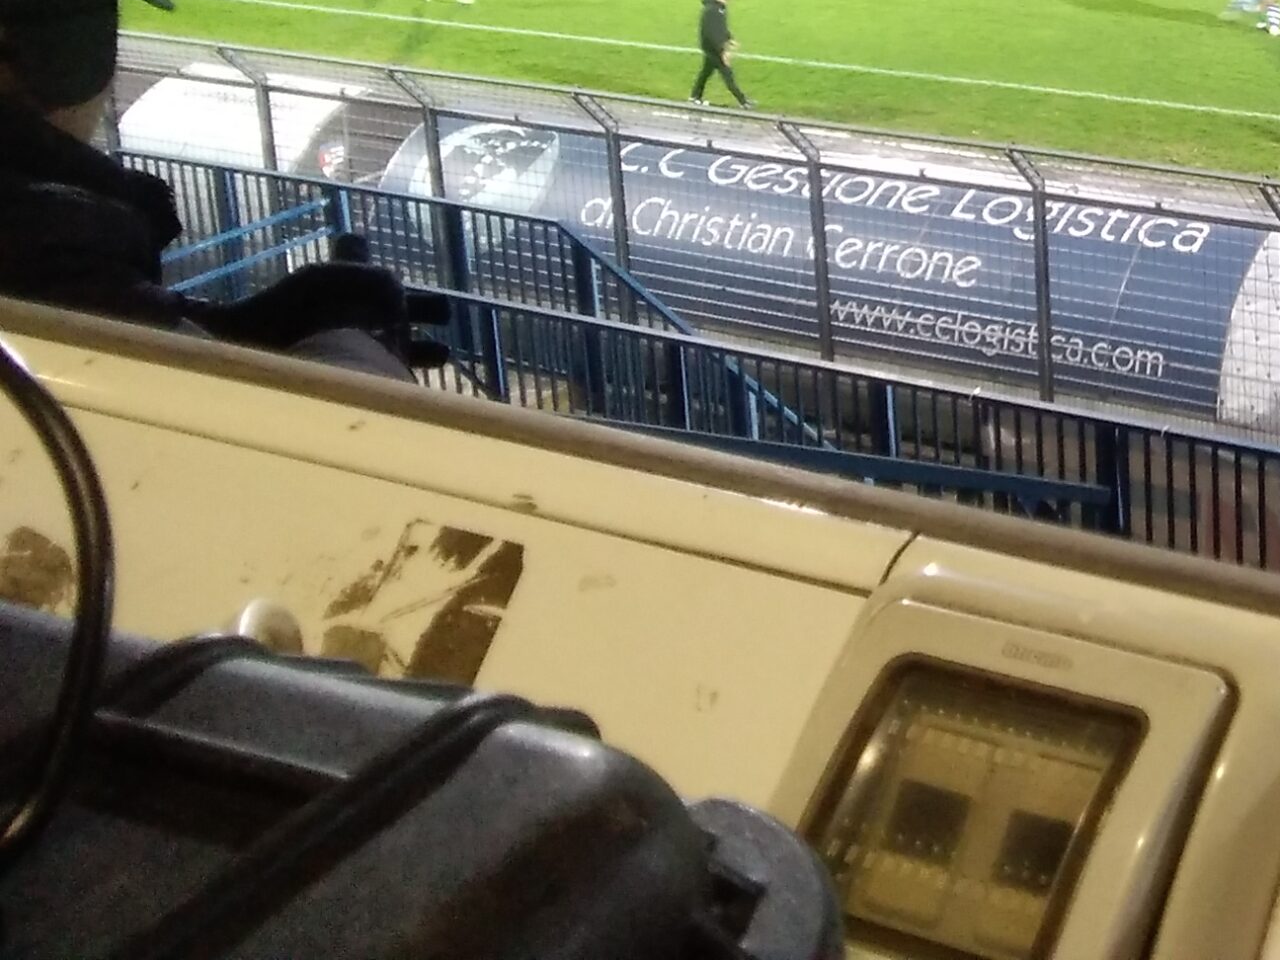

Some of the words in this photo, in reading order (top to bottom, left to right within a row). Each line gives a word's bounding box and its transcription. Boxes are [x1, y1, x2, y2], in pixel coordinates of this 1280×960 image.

[632, 195, 794, 258] Christian
[951, 189, 1212, 254] Logistica
[829, 299, 1165, 378] www.cclogistca.com
